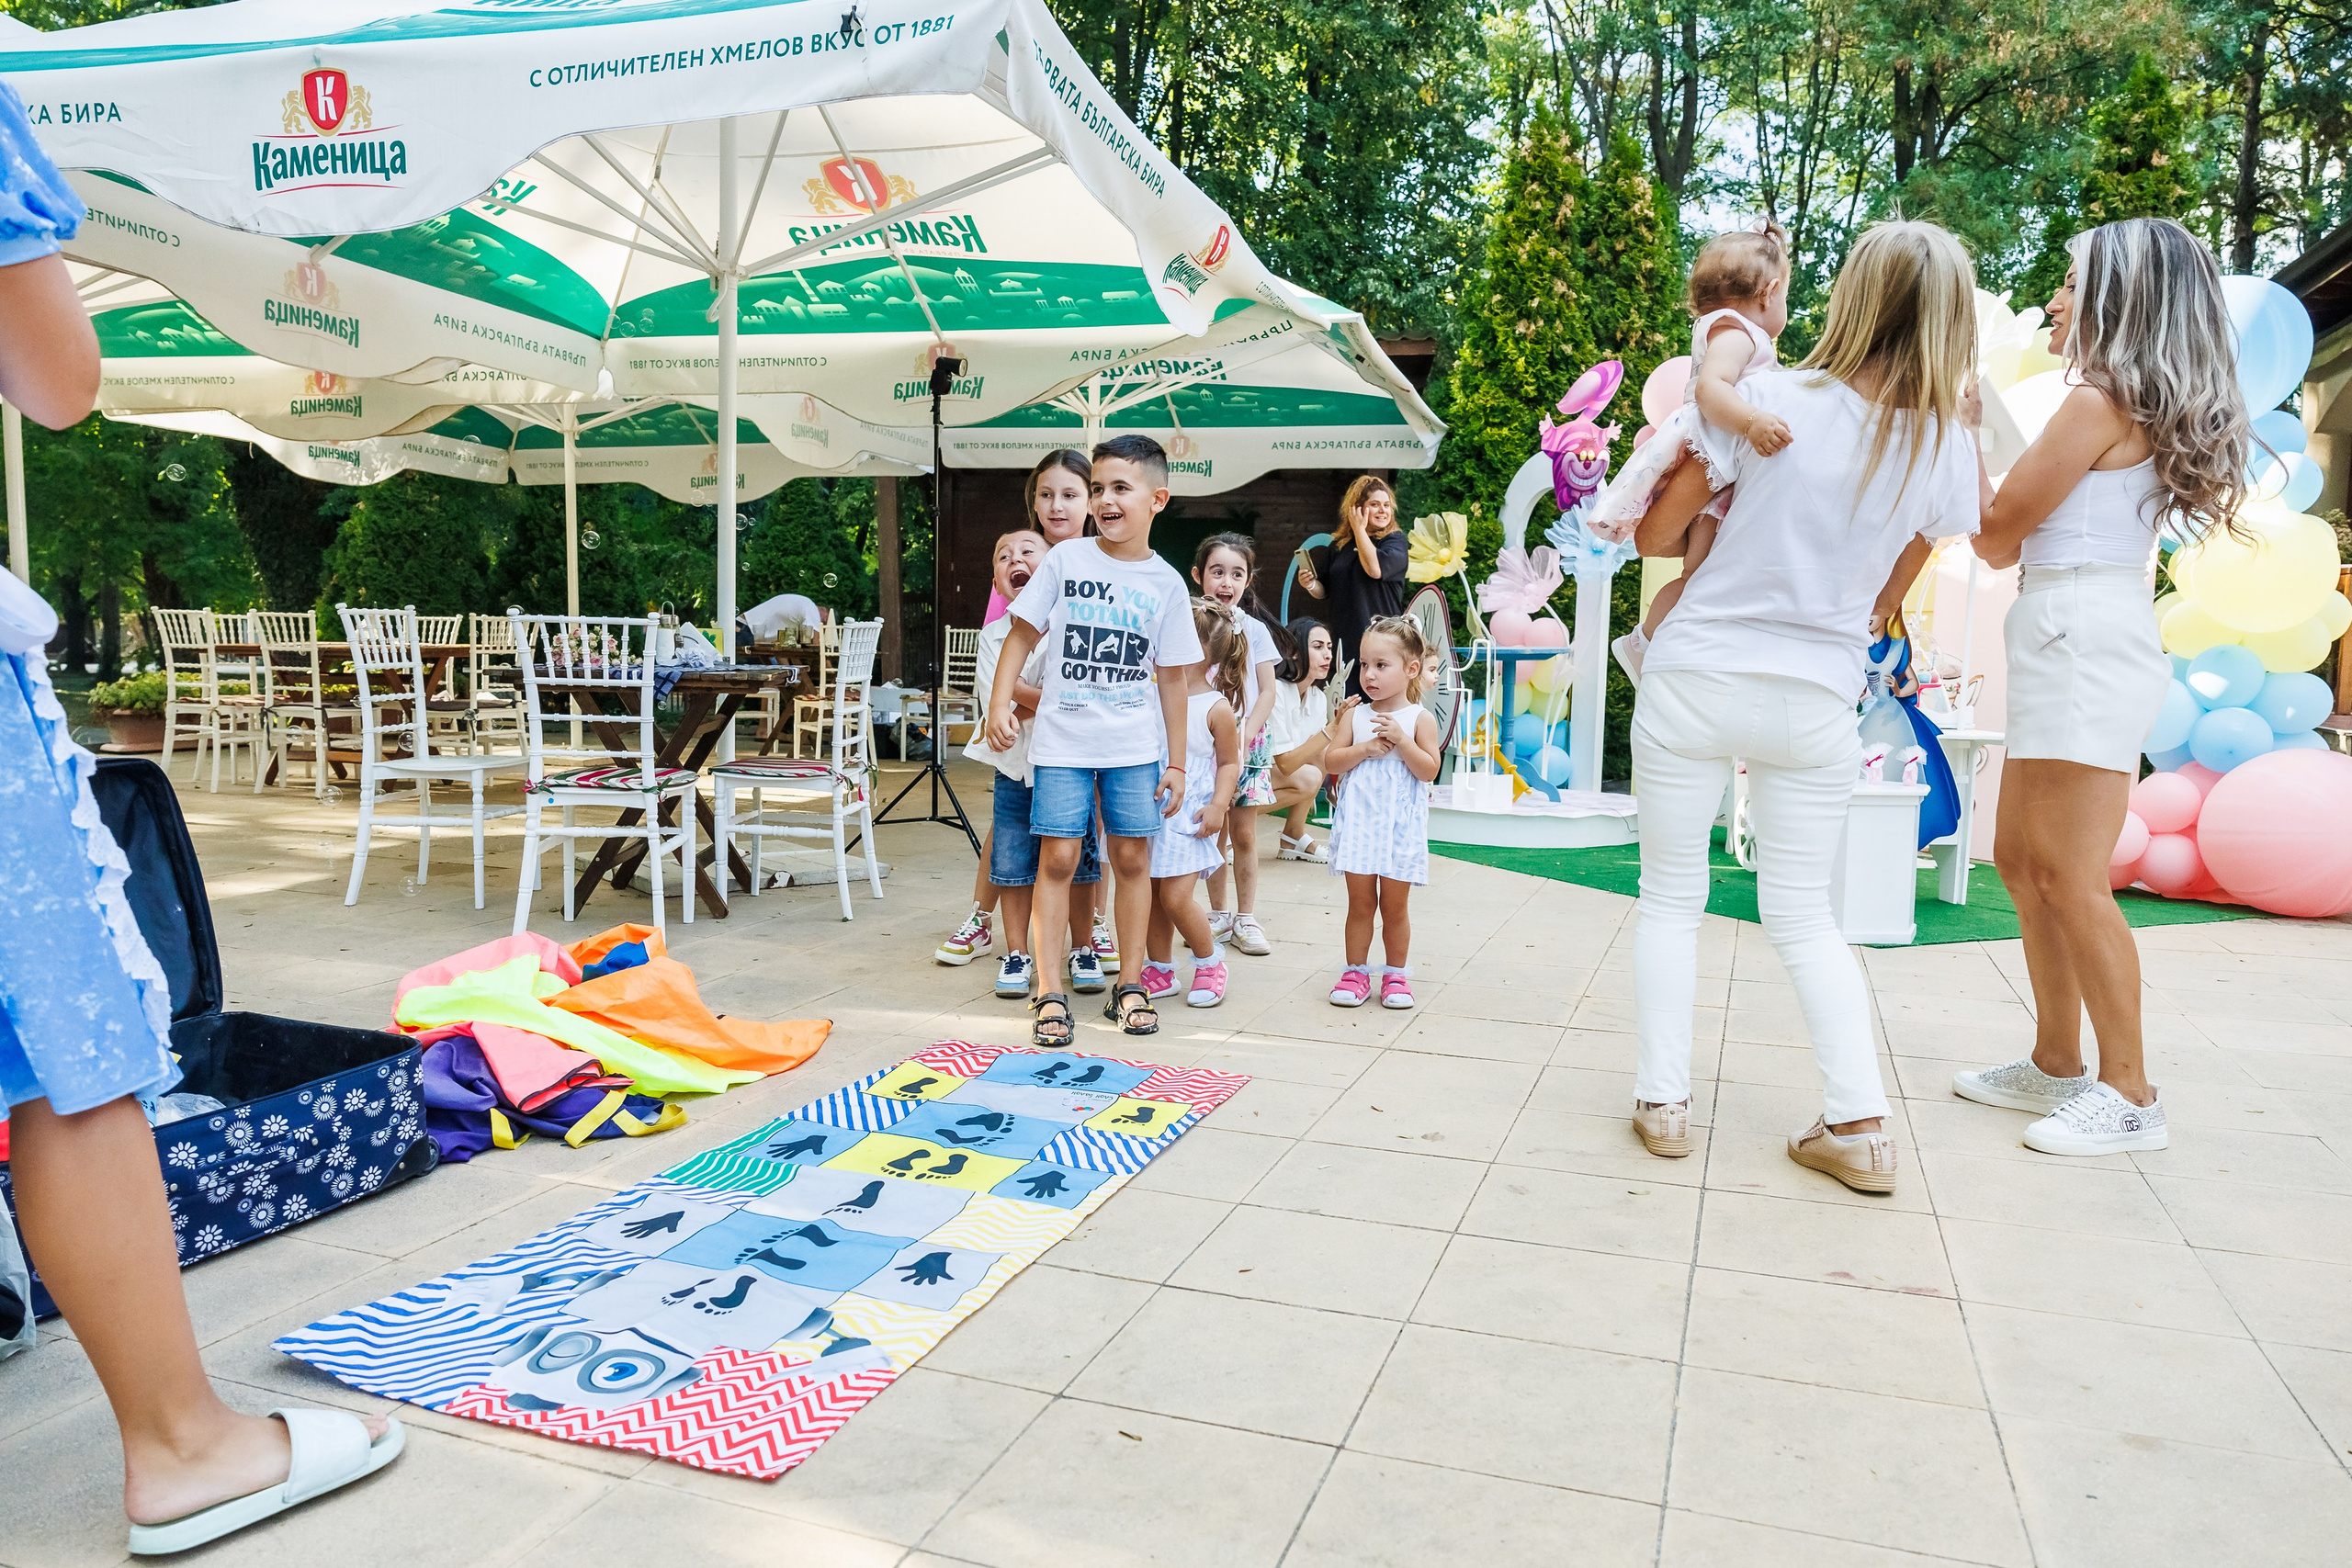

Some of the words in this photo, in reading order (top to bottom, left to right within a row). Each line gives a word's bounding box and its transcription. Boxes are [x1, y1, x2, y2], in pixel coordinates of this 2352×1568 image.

[529, 69, 543, 88] С
[548, 49, 705, 85] ОТЛИЧИТЕЛЕН
[710, 36, 804, 65] ХМЕЛОВ
[811, 28, 868, 53] ВКУС
[874, 23, 906, 45] ОТ
[911, 15, 955, 39] 1881
[62, 102, 122, 125] БИРА
[315, 76, 338, 121] К
[252, 140, 407, 191] Каменица
[1081, 100, 1142, 175] БЪЛГАРСКА
[1140, 162, 1166, 199] БИРА
[1064, 579, 1114, 604] BOY,
[1122, 585, 1161, 616] YOU
[1068, 602, 1150, 632] TOTALL
[1061, 661, 1102, 682] GOT
[1104, 664, 1148, 683] THIS
[1059, 690, 1080, 700] JUST
[1081, 692, 1096, 700] DO
[1098, 693, 1116, 702] THE
[2124, 1119, 2139, 1132] DG
